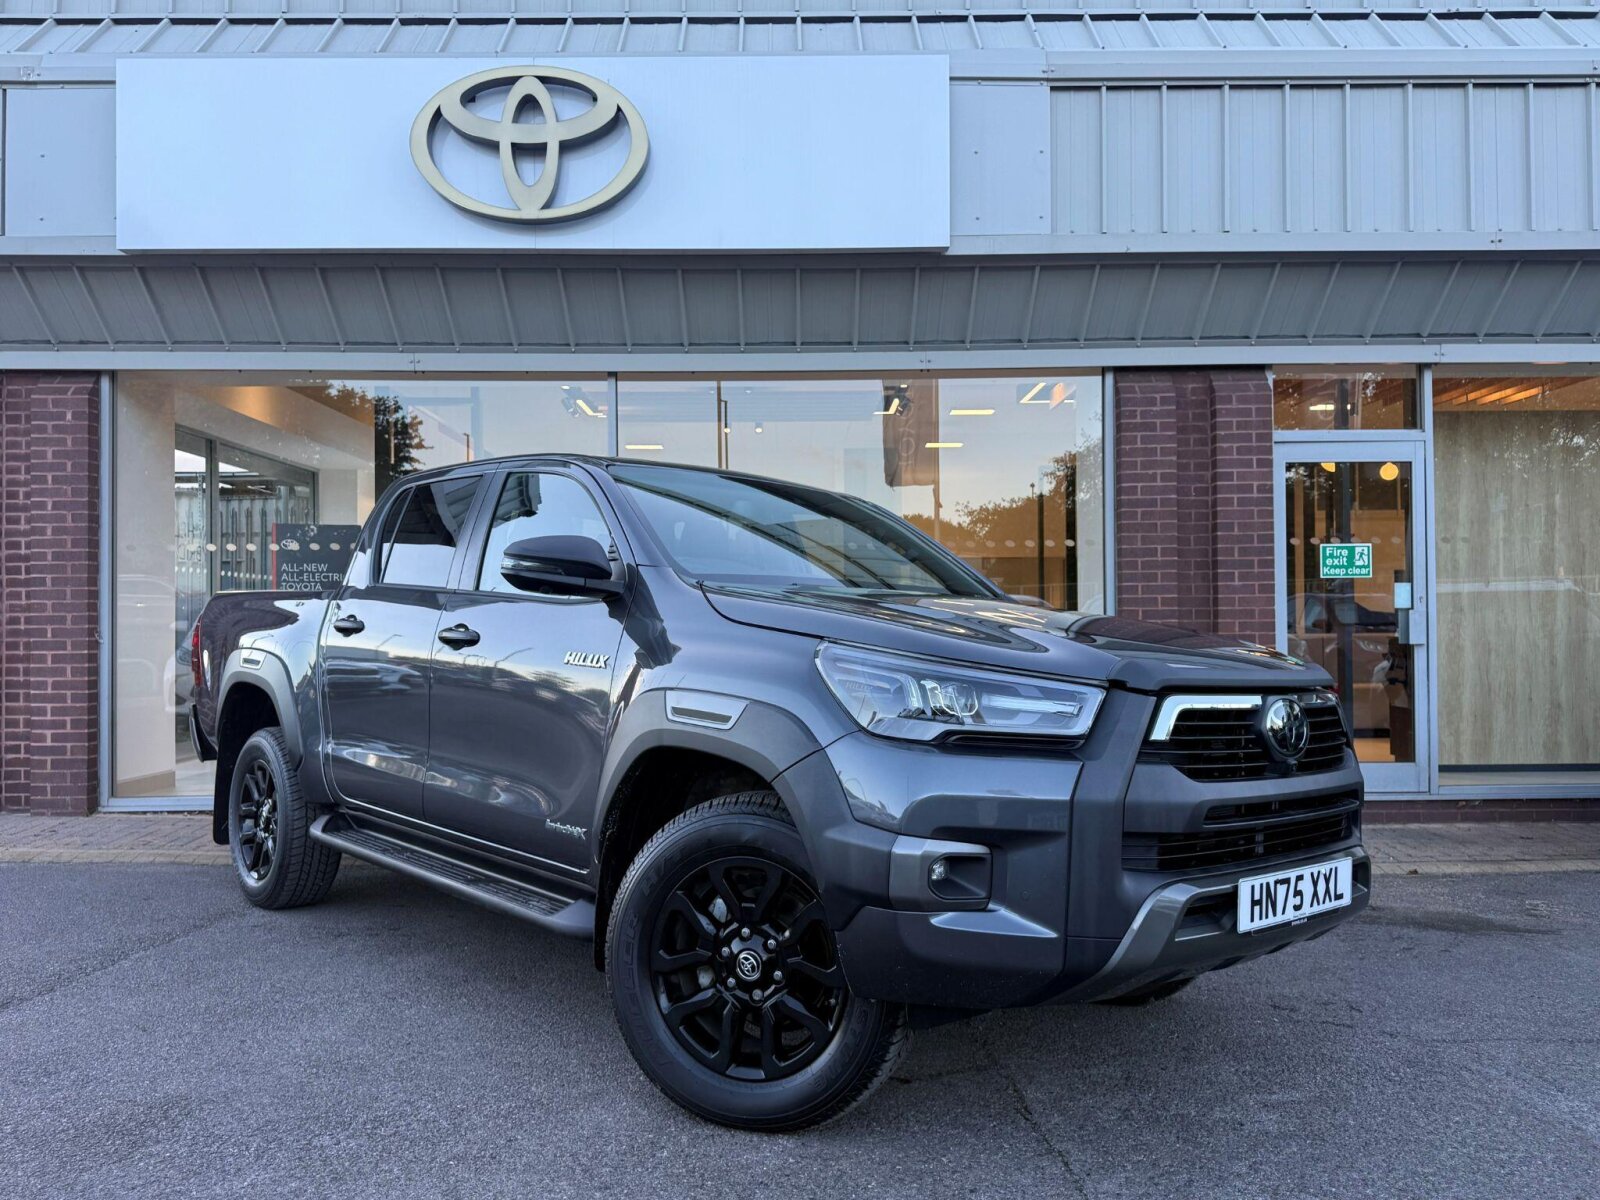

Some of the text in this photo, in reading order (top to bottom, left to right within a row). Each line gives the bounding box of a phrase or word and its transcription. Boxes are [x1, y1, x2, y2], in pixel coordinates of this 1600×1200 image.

[1326, 547, 1349, 557] Fire
[1326, 556, 1348, 566] exit
[280, 563, 328, 572] ALL-NEW
[1323, 566, 1370, 576] Keep clear
[281, 582, 323, 591] TOYOTA
[564, 651, 610, 669] HILUX
[1250, 866, 1344, 923] HN75 XXL
